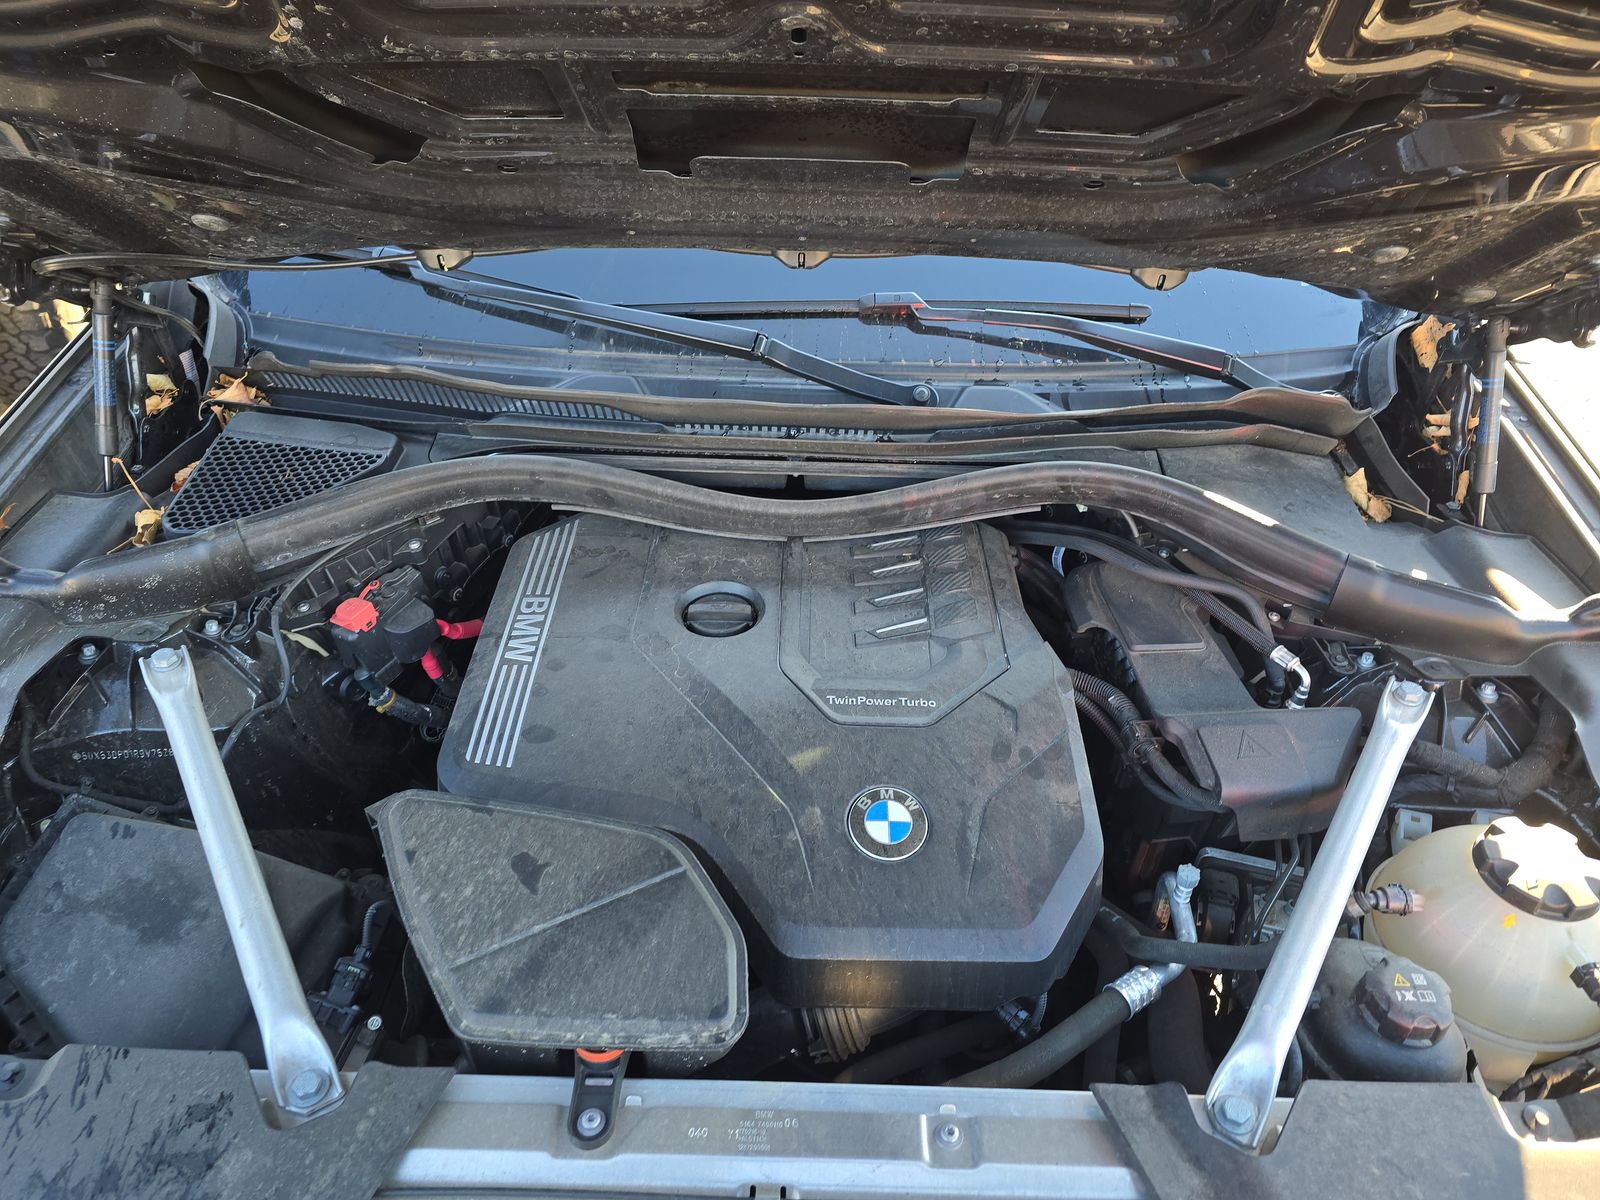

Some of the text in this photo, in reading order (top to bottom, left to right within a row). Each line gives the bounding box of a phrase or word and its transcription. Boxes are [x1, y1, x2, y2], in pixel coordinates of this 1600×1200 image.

[504, 597, 551, 662] BMW
[826, 695, 937, 708] TwinPower Turbo
[856, 788, 921, 812] BMW
